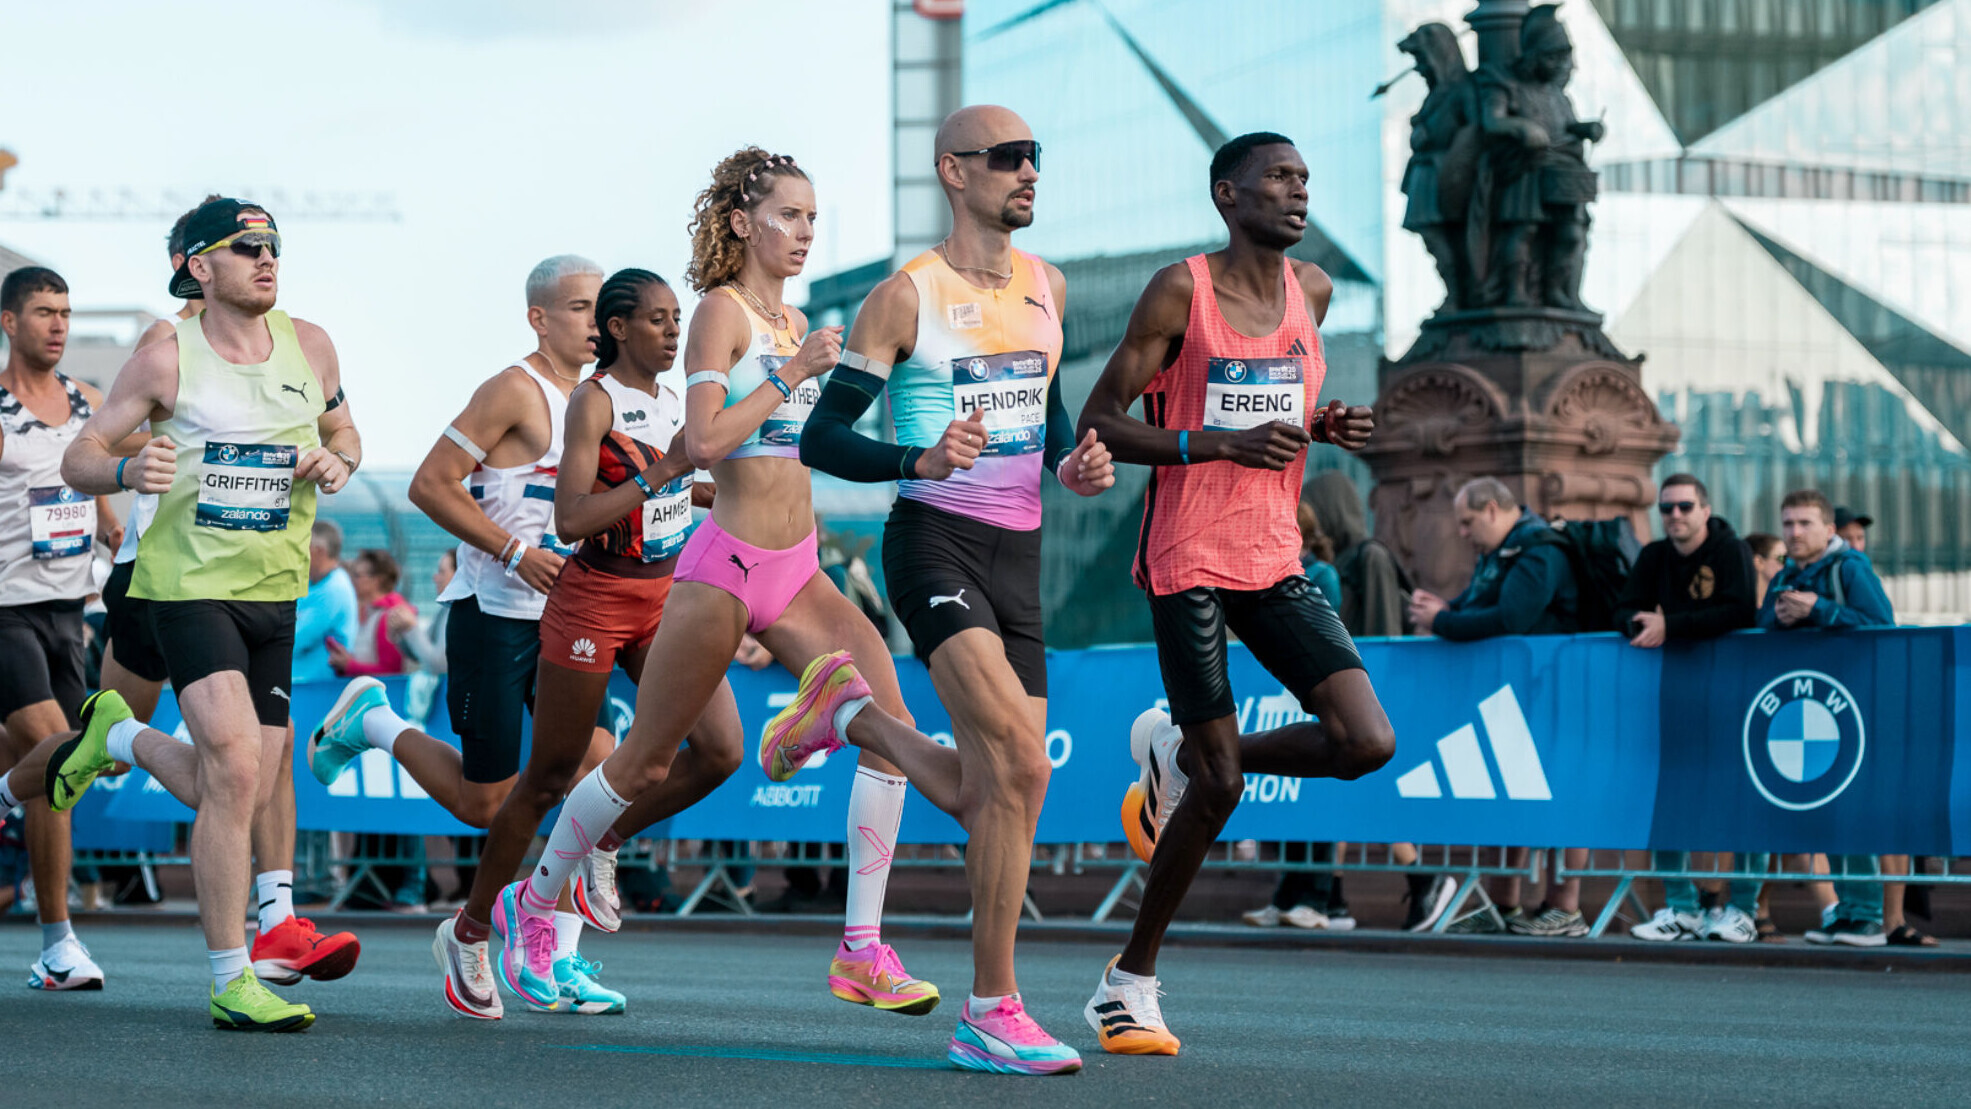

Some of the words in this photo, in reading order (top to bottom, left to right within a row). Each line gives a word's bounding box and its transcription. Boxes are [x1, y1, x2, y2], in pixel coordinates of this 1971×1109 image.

[961, 387, 1044, 413] HENDRIK
[1221, 393, 1292, 412] ERENG
[1021, 412, 1041, 423] PACE
[987, 430, 1031, 444] zalando
[206, 473, 290, 492] GRIFFITHS
[45, 505, 87, 522] 79980
[221, 509, 271, 521] zalando
[651, 496, 689, 525] AHMED
[1759, 678, 1849, 717] BMW
[750, 786, 822, 807] ABBOTT
